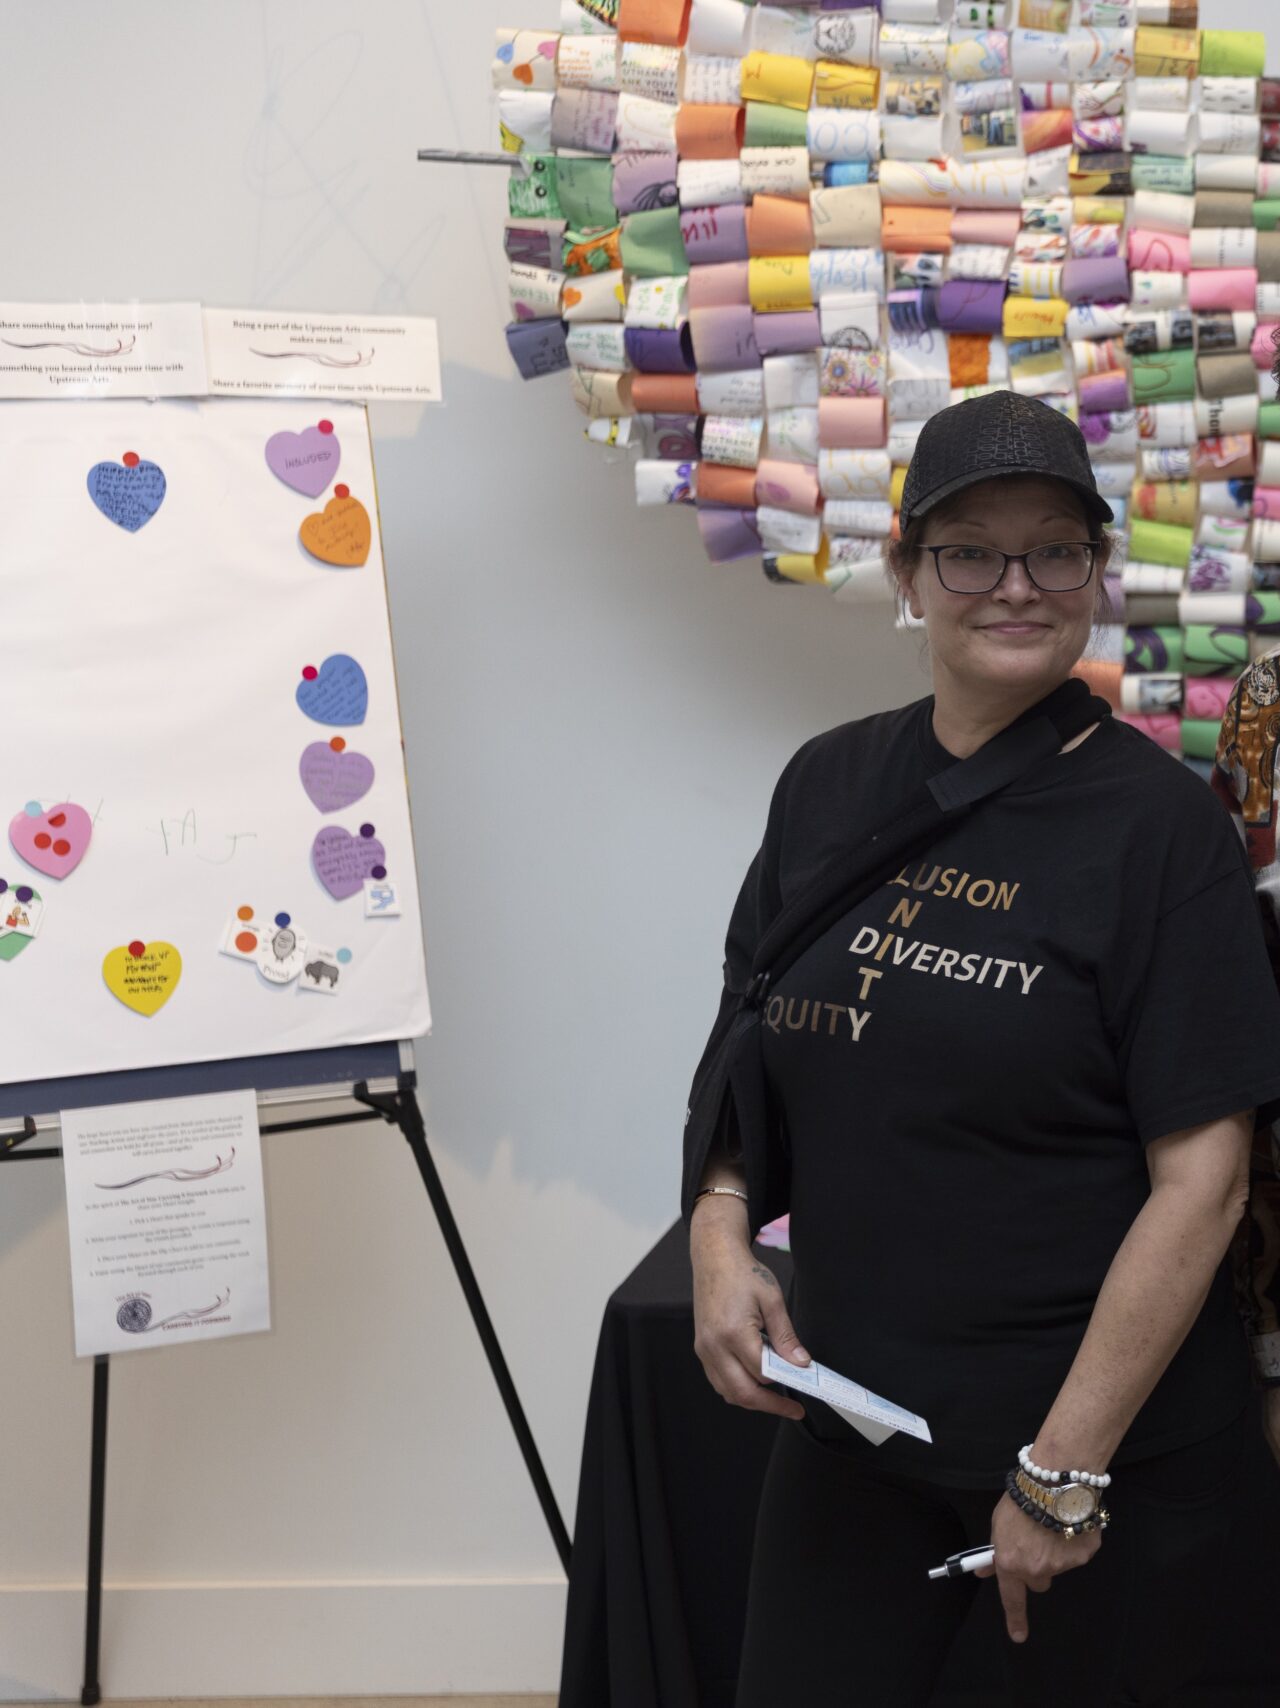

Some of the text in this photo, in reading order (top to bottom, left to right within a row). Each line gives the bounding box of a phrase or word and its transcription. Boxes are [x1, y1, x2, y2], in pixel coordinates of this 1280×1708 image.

[22, 322, 66, 330] something
[86, 322, 119, 331] brought
[232, 320, 255, 330] Being
[263, 323, 279, 331] part
[290, 323, 303, 331] the
[305, 323, 342, 332] Upstream
[344, 325, 360, 333] Arts
[45, 365, 59, 373] you
[61, 364, 92, 372] learned
[94, 364, 123, 373] during
[212, 379, 234, 387] Share
[886, 862, 1020, 911] LUSION
[848, 926, 1044, 995] DIVERSITY
[762, 995, 872, 1042] QUITY
